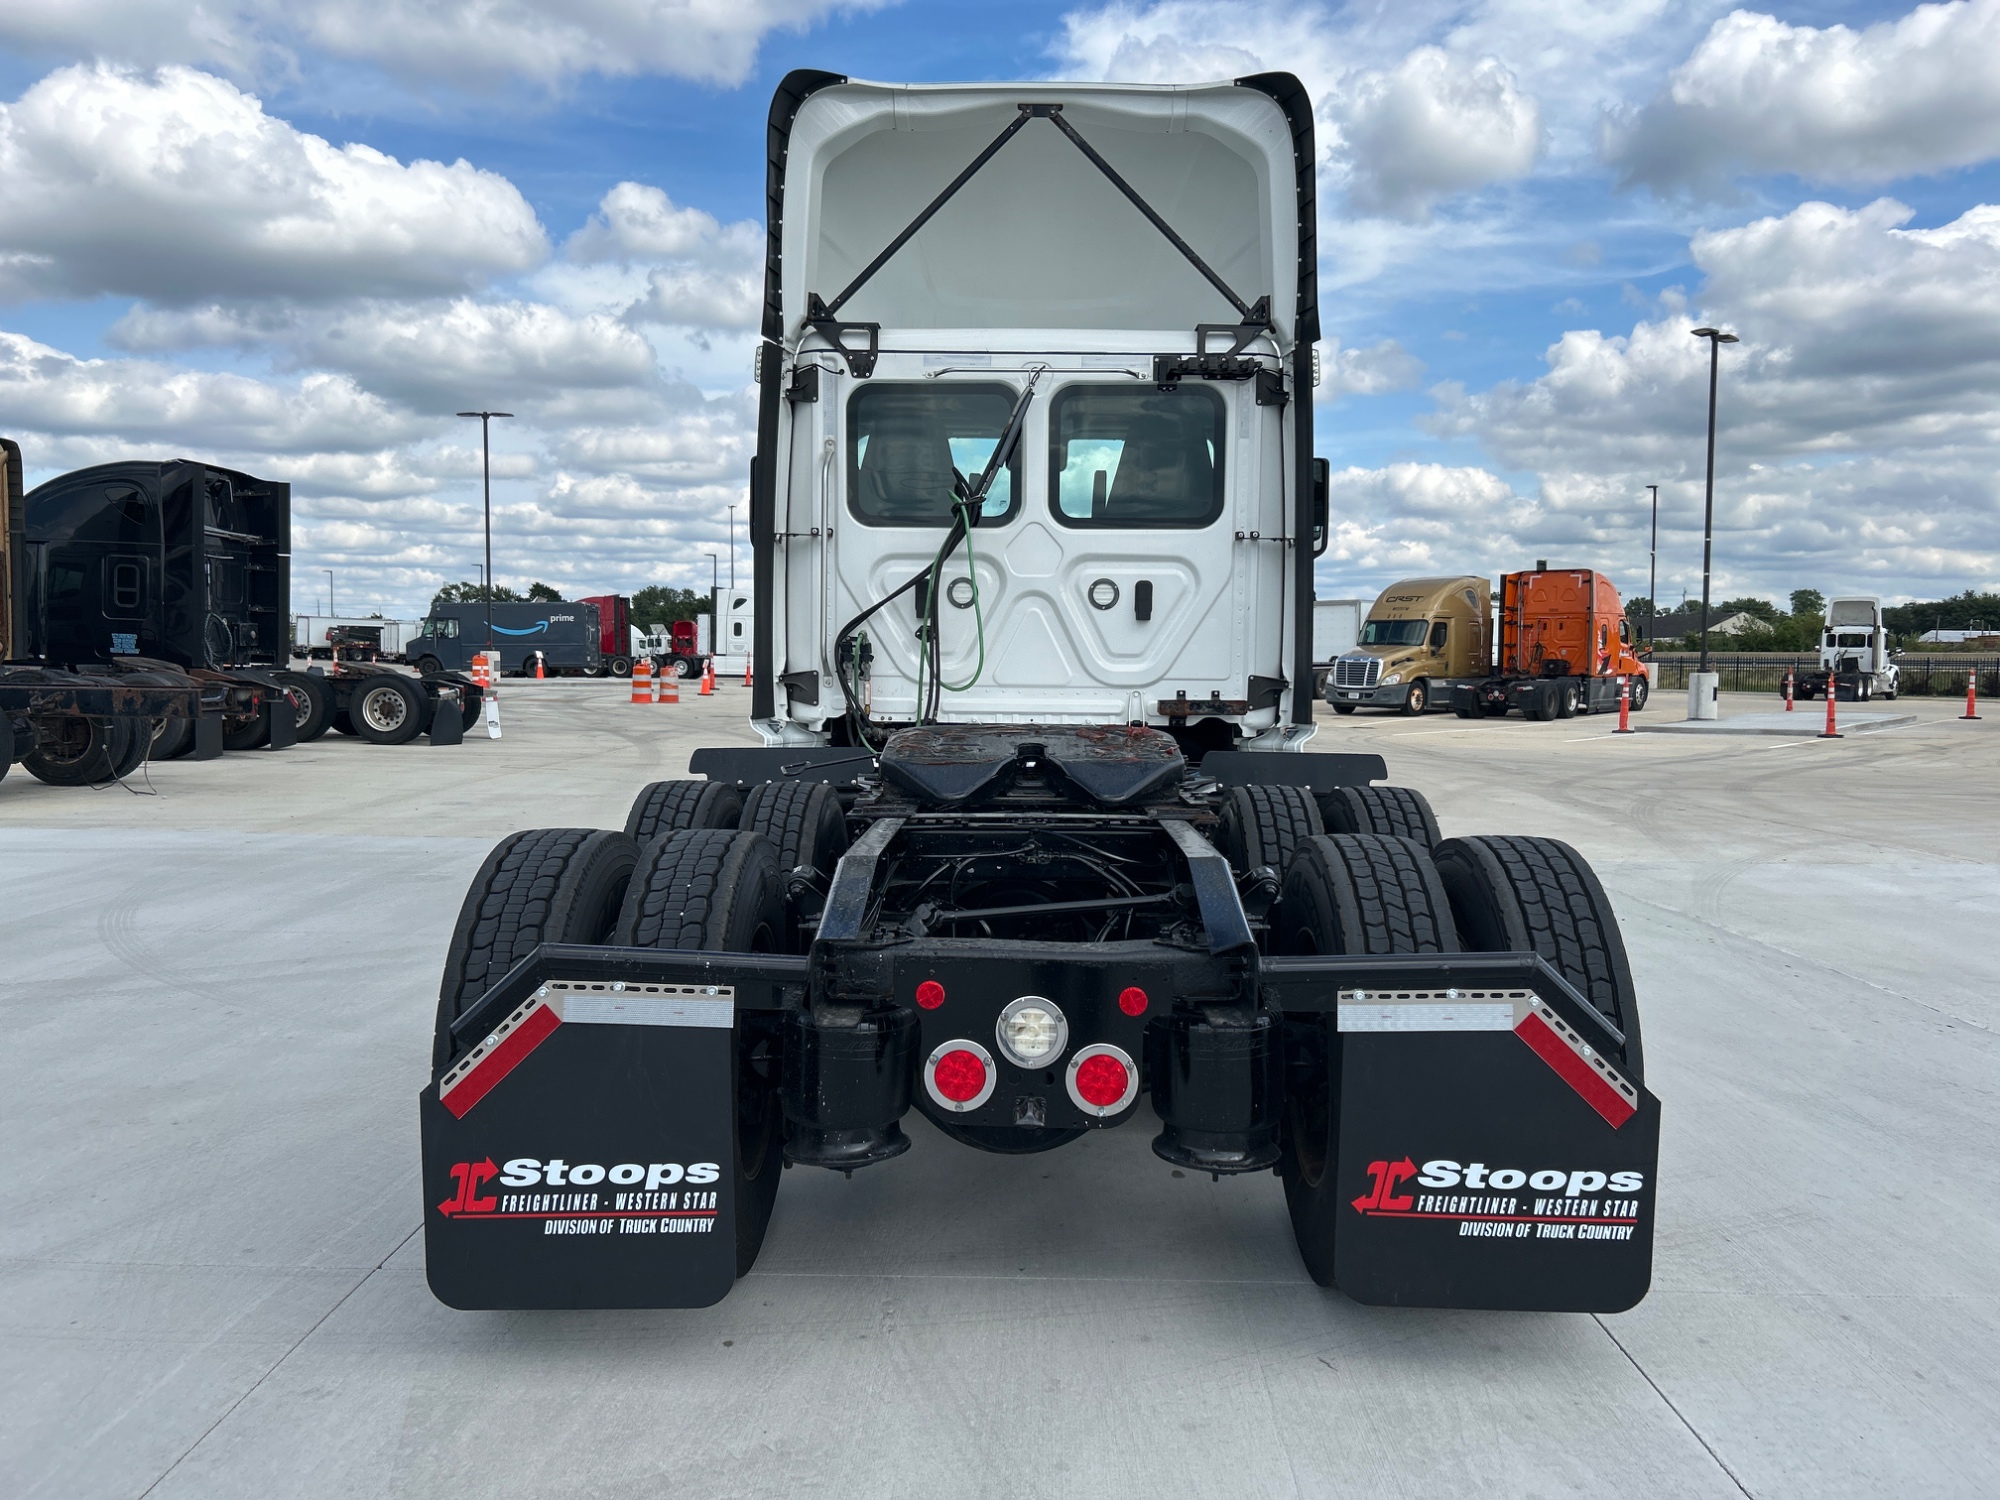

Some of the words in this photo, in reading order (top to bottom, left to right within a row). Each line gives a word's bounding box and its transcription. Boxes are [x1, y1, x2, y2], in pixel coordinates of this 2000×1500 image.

[1386, 595, 1425, 603] CRST
[550, 613, 575, 624] prime
[499, 1158, 721, 1191] Stoops
[1417, 1159, 1644, 1197] Stoops
[501, 1193, 598, 1213] FREIGHTLINER
[615, 1192, 678, 1211] WESTERN
[682, 1191, 717, 1210] STAR
[1417, 1194, 1517, 1215] FREIGHTLINER
[1533, 1198, 1599, 1217] WESTERN
[1602, 1199, 1639, 1218] STAR
[544, 1219, 598, 1235] DIVISION
[598, 1218, 615, 1234] OF
[619, 1218, 658, 1234] TRUCK
[659, 1217, 715, 1234] COUNTRY
[1458, 1221, 1515, 1238] DIVISION
[1515, 1222, 1532, 1238] OF
[1535, 1222, 1577, 1239] TRUCK
[1577, 1223, 1635, 1241] COUNTRY
